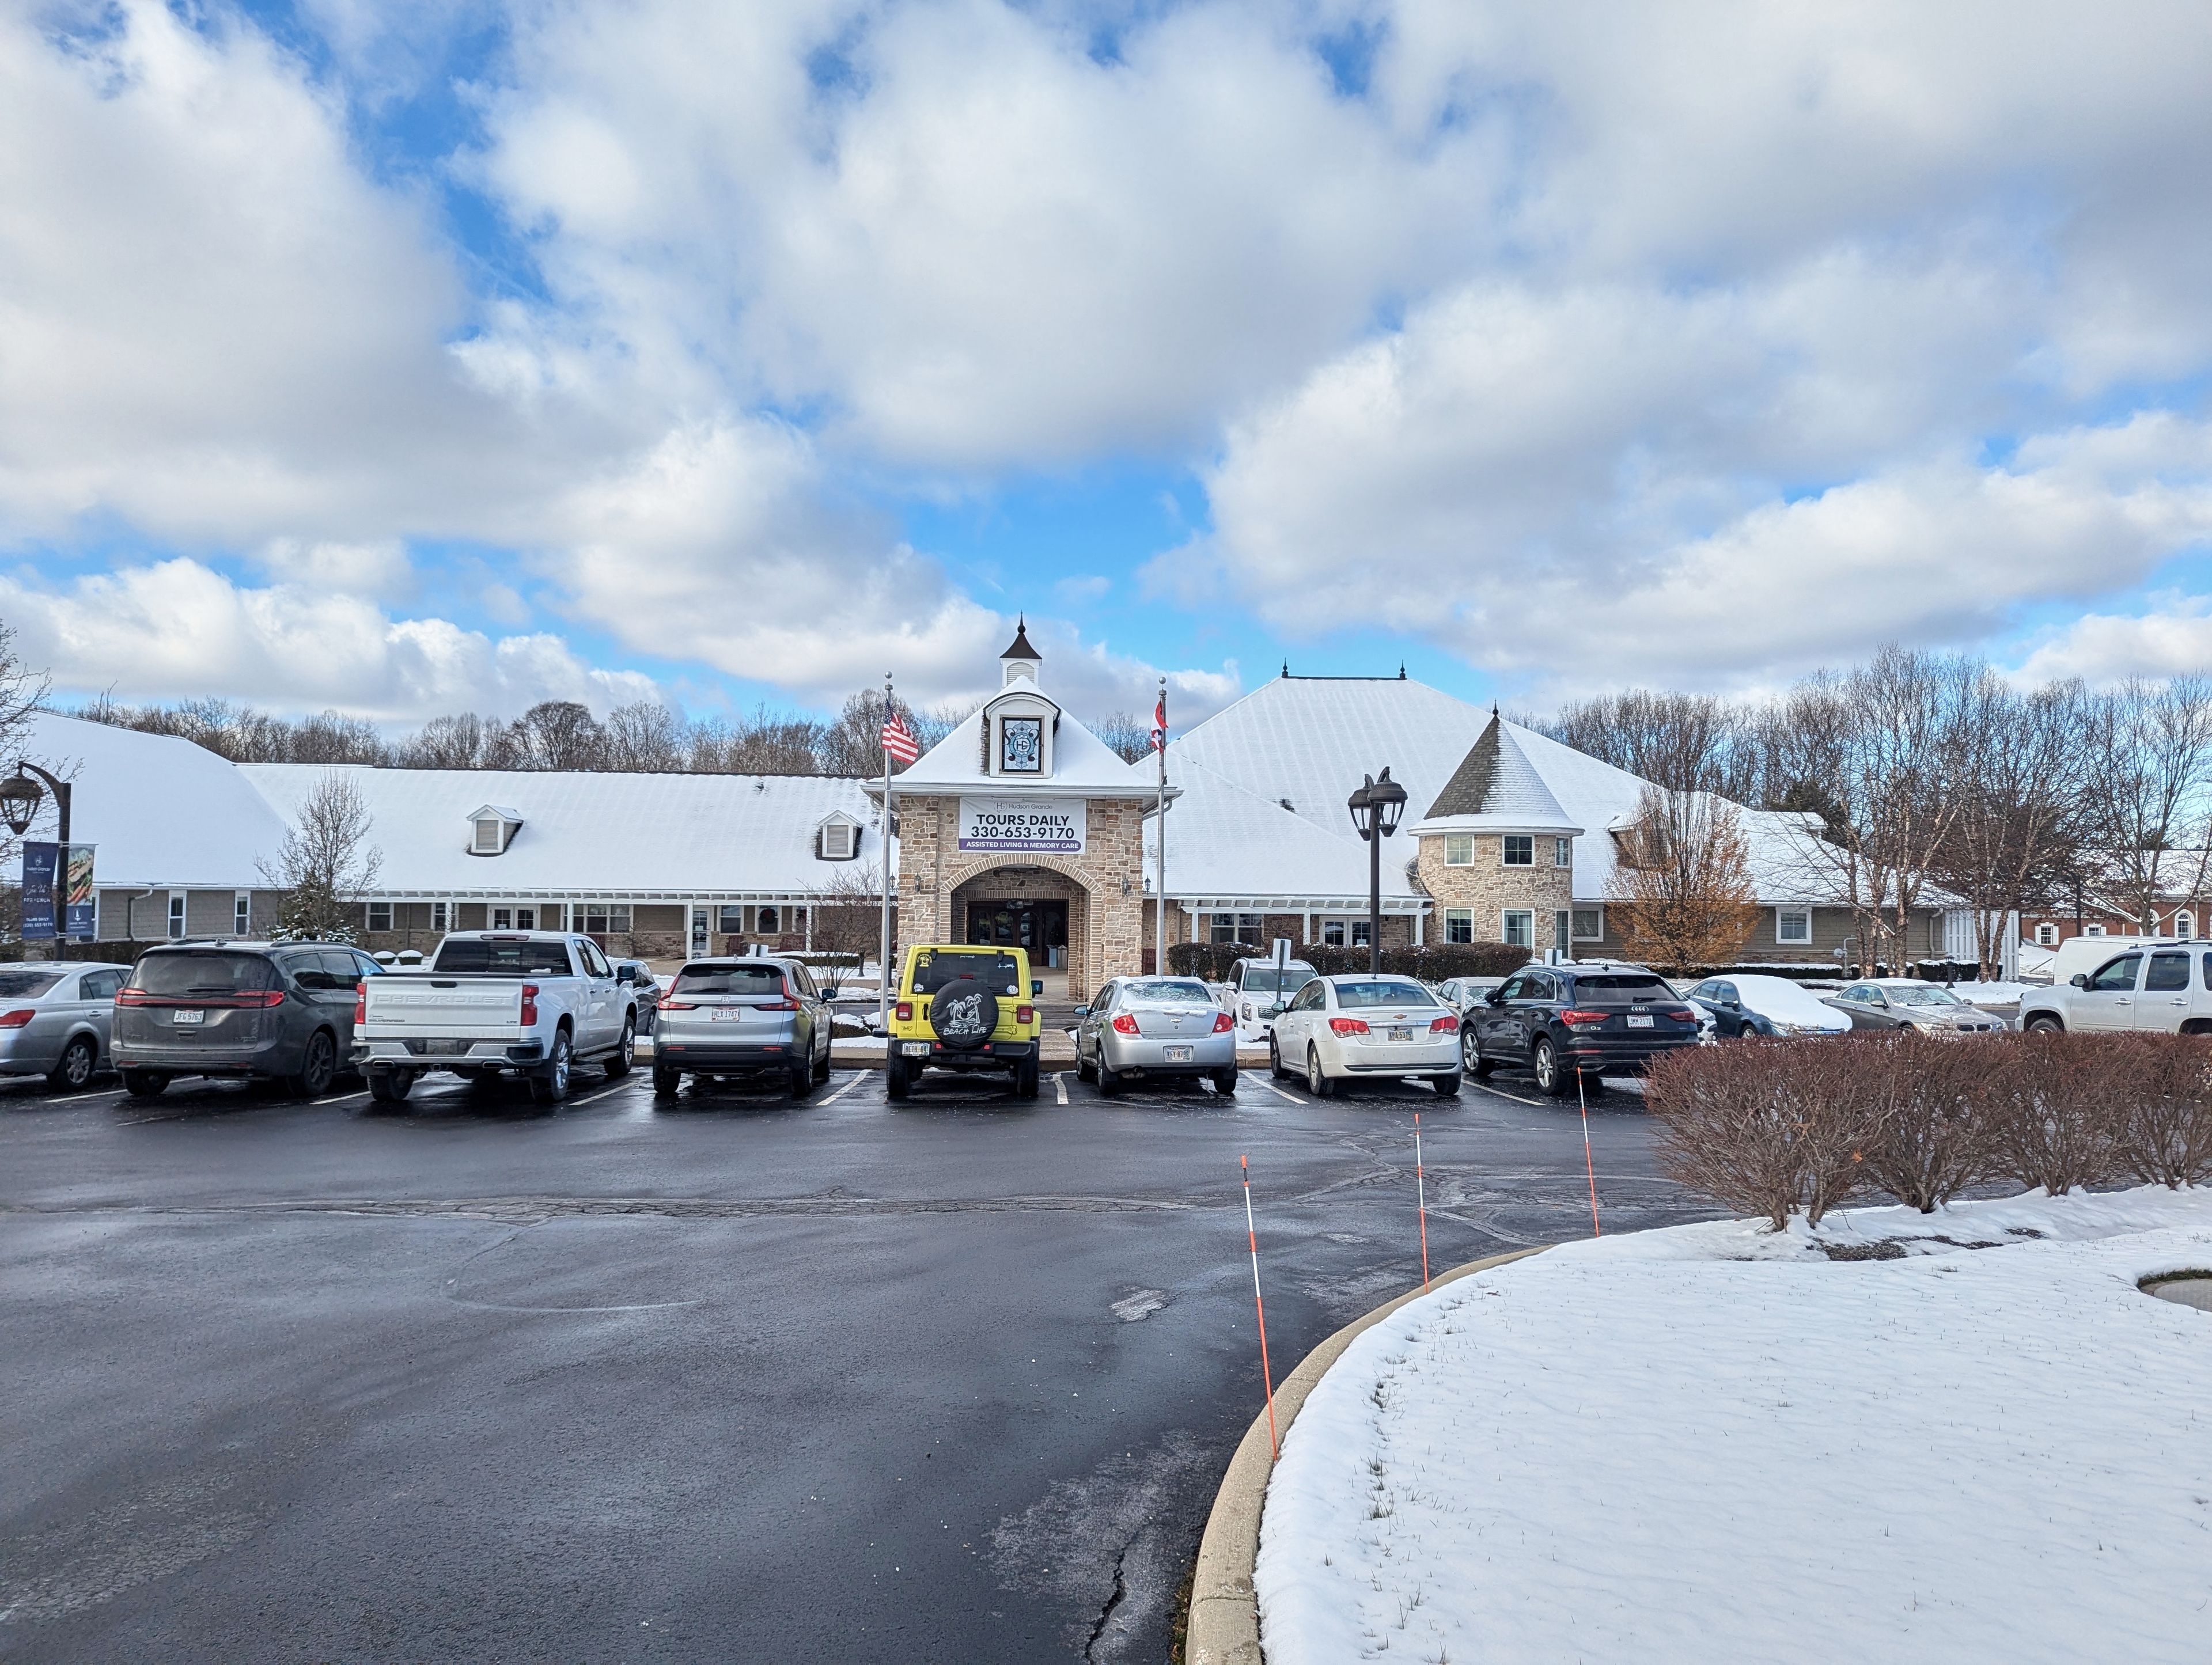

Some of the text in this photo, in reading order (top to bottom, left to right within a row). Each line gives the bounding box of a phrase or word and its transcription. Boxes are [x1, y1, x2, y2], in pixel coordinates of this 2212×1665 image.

[976, 814, 1070, 826] TOURS DAILY
[971, 826, 1074, 839] 330-653-9170
[944, 1026, 987, 1036] BEACH LIFE
